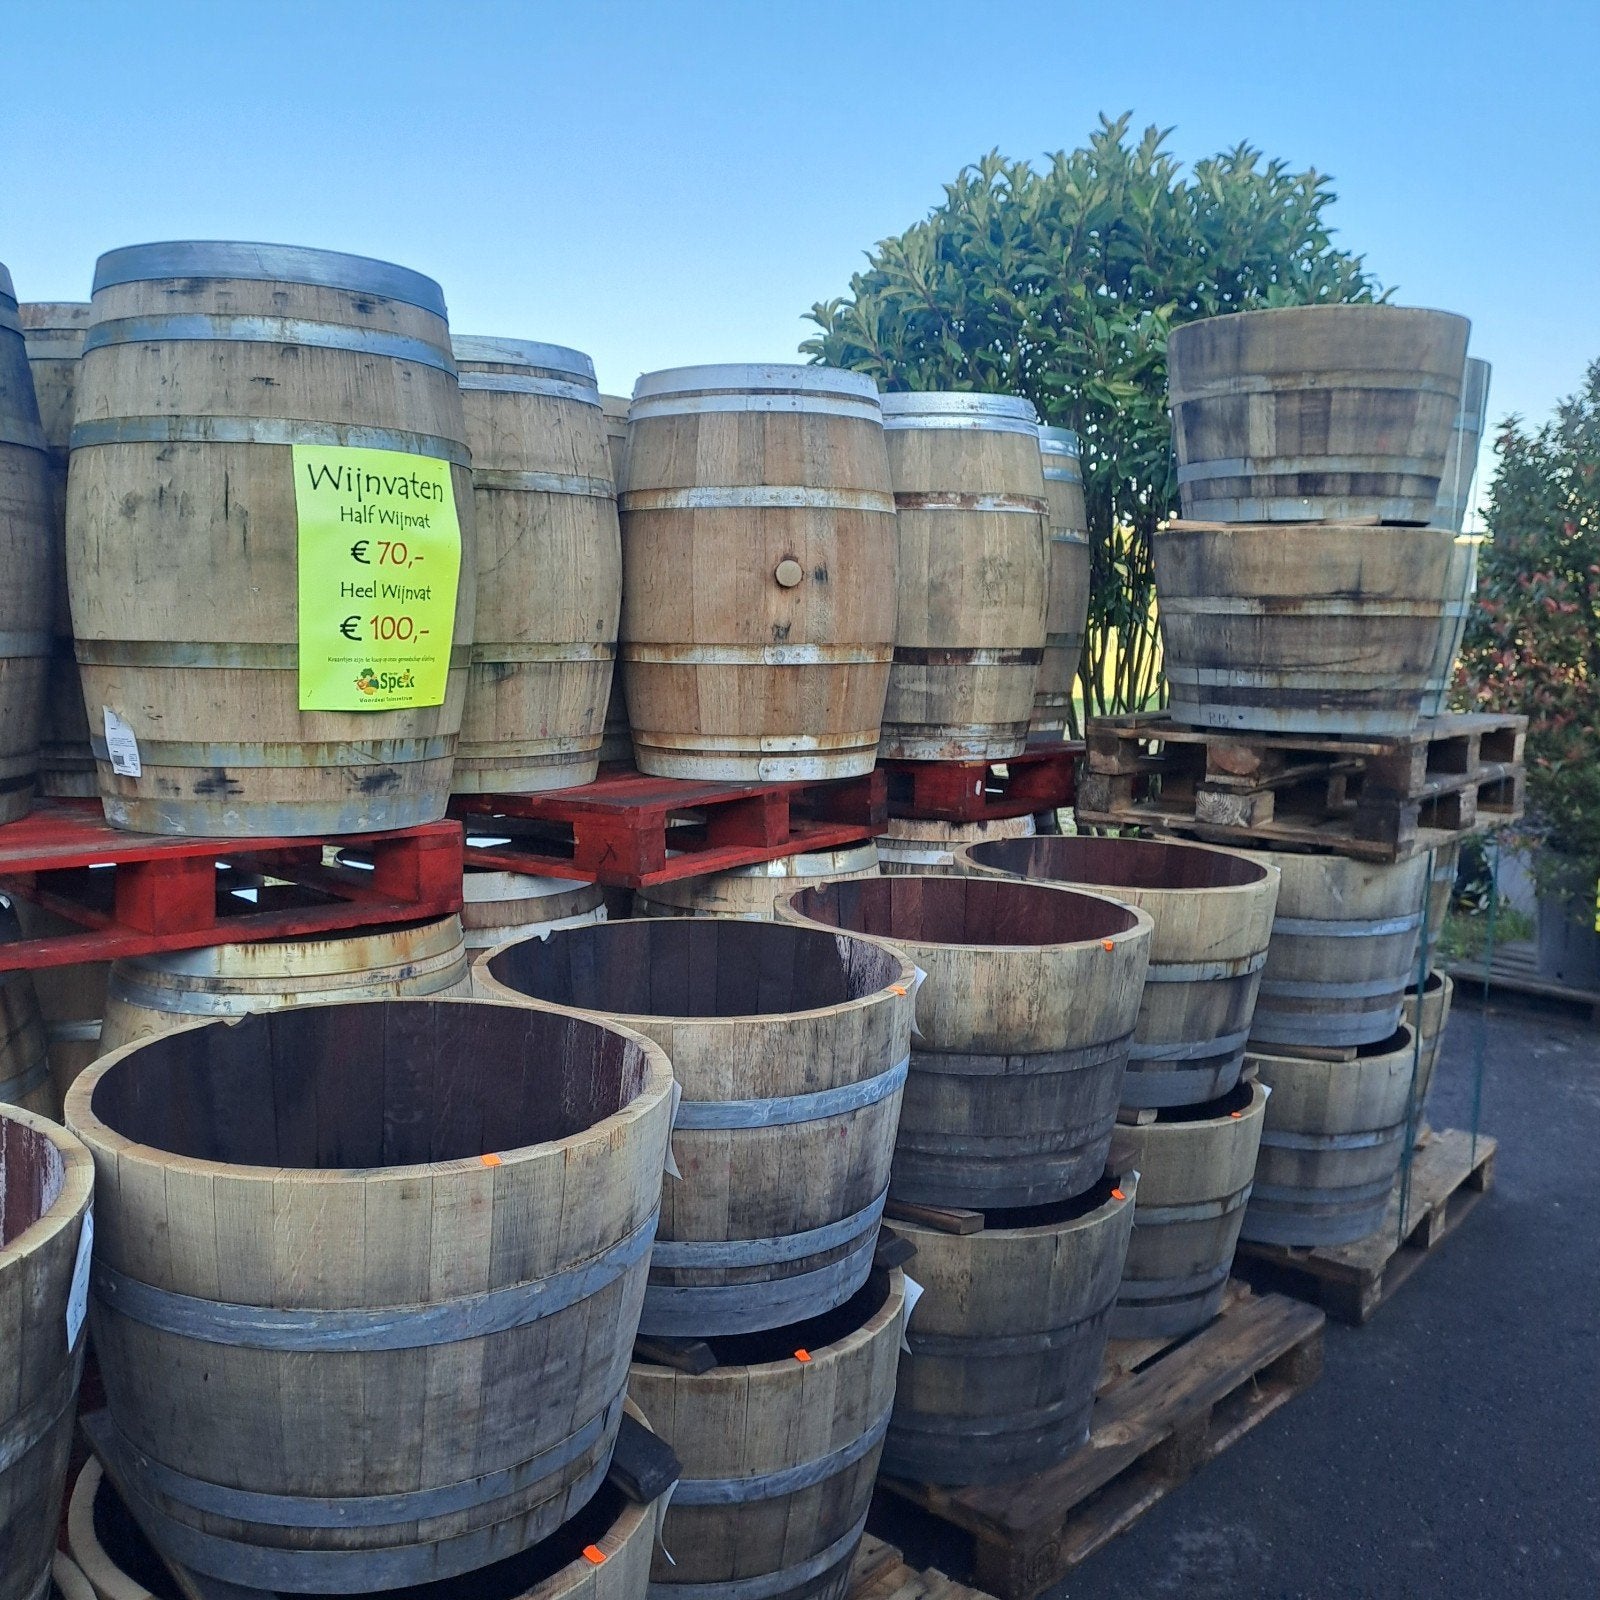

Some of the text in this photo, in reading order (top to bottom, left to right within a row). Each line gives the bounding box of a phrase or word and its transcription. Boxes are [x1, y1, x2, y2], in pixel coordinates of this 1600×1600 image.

[307, 463, 443, 502] Wijnvaten
[340, 505, 431, 531] Half Wijnvat
[350, 540, 424, 569] € 70,-
[340, 580, 432, 604] Heel Wijnvat
[339, 614, 430, 644] € 100,-
[380, 668, 415, 693] Spek
